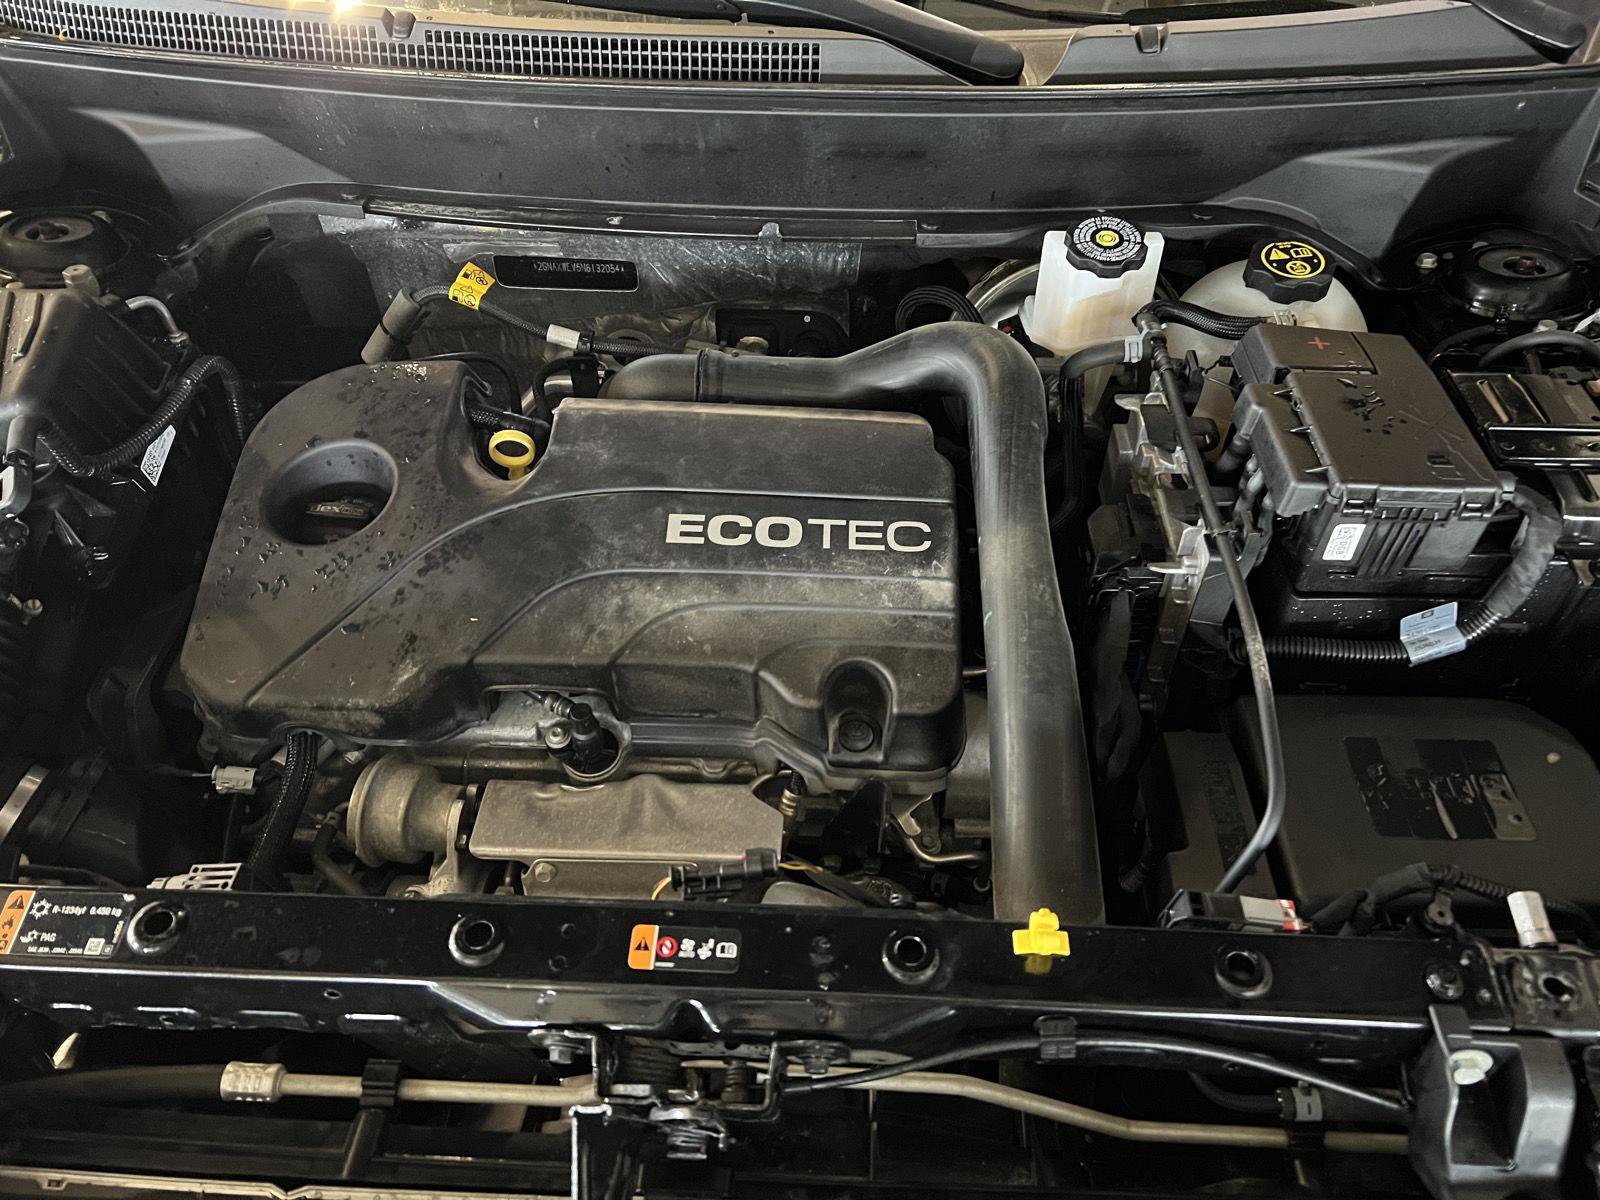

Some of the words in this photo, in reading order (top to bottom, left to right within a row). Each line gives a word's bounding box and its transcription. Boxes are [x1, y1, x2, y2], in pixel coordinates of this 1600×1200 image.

[665, 513, 932, 552] ECOTEC
[52, 904, 87, 916] R-1234yf
[40, 932, 57, 942] PAG
